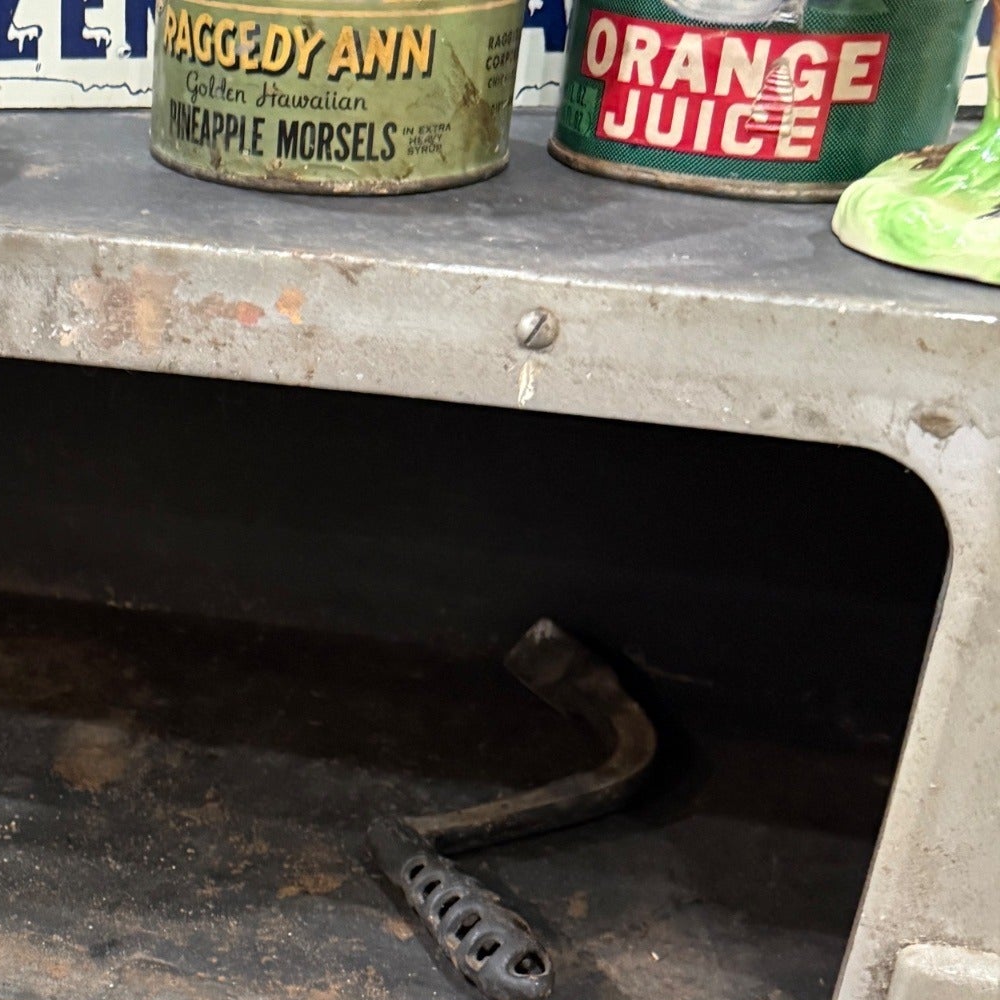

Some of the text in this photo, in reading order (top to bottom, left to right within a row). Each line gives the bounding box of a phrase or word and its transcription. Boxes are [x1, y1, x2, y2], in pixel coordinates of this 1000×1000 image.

[163, 5, 436, 80] RAGGEDY ANN
[586, 17, 883, 103] ORANGE
[186, 70, 368, 111] Golden Hawaiian
[170, 97, 397, 163] PINEAPPLE MORSELS
[402, 122, 451, 136] IN EXTRA
[602, 90, 821, 159] JUICE
